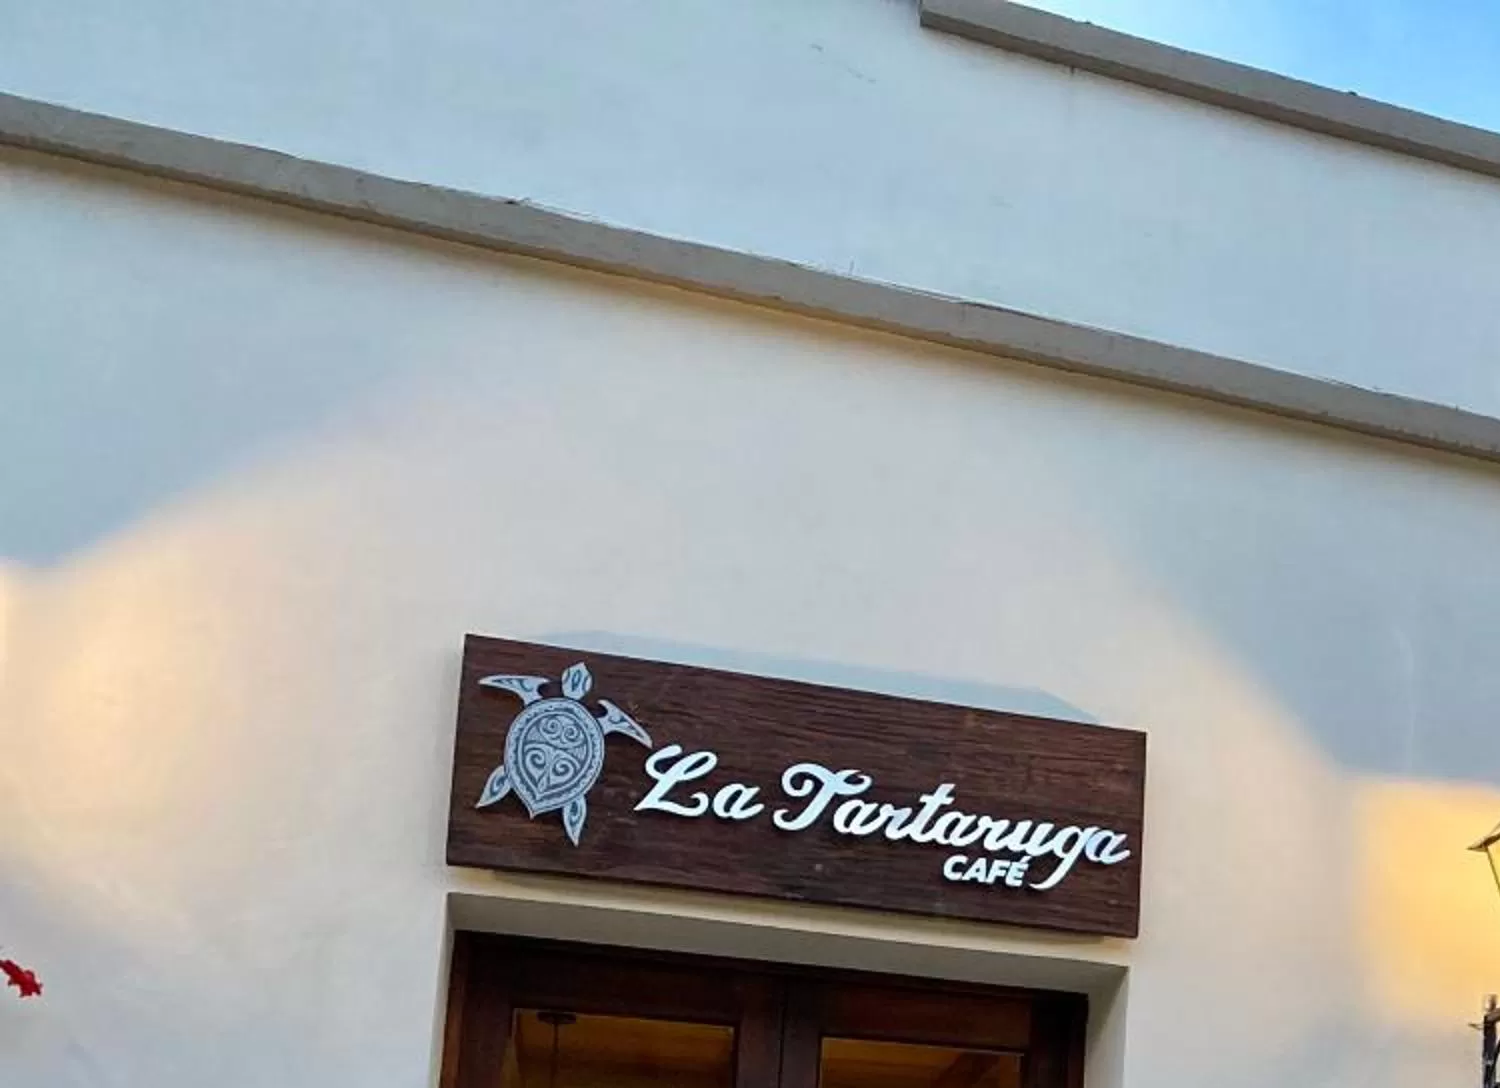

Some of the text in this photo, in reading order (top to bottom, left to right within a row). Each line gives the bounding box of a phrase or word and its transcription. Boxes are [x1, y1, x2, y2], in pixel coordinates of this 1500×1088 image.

[634, 744, 1131, 891] La Tartaruga
[943, 854, 1032, 887] CAFÉ
